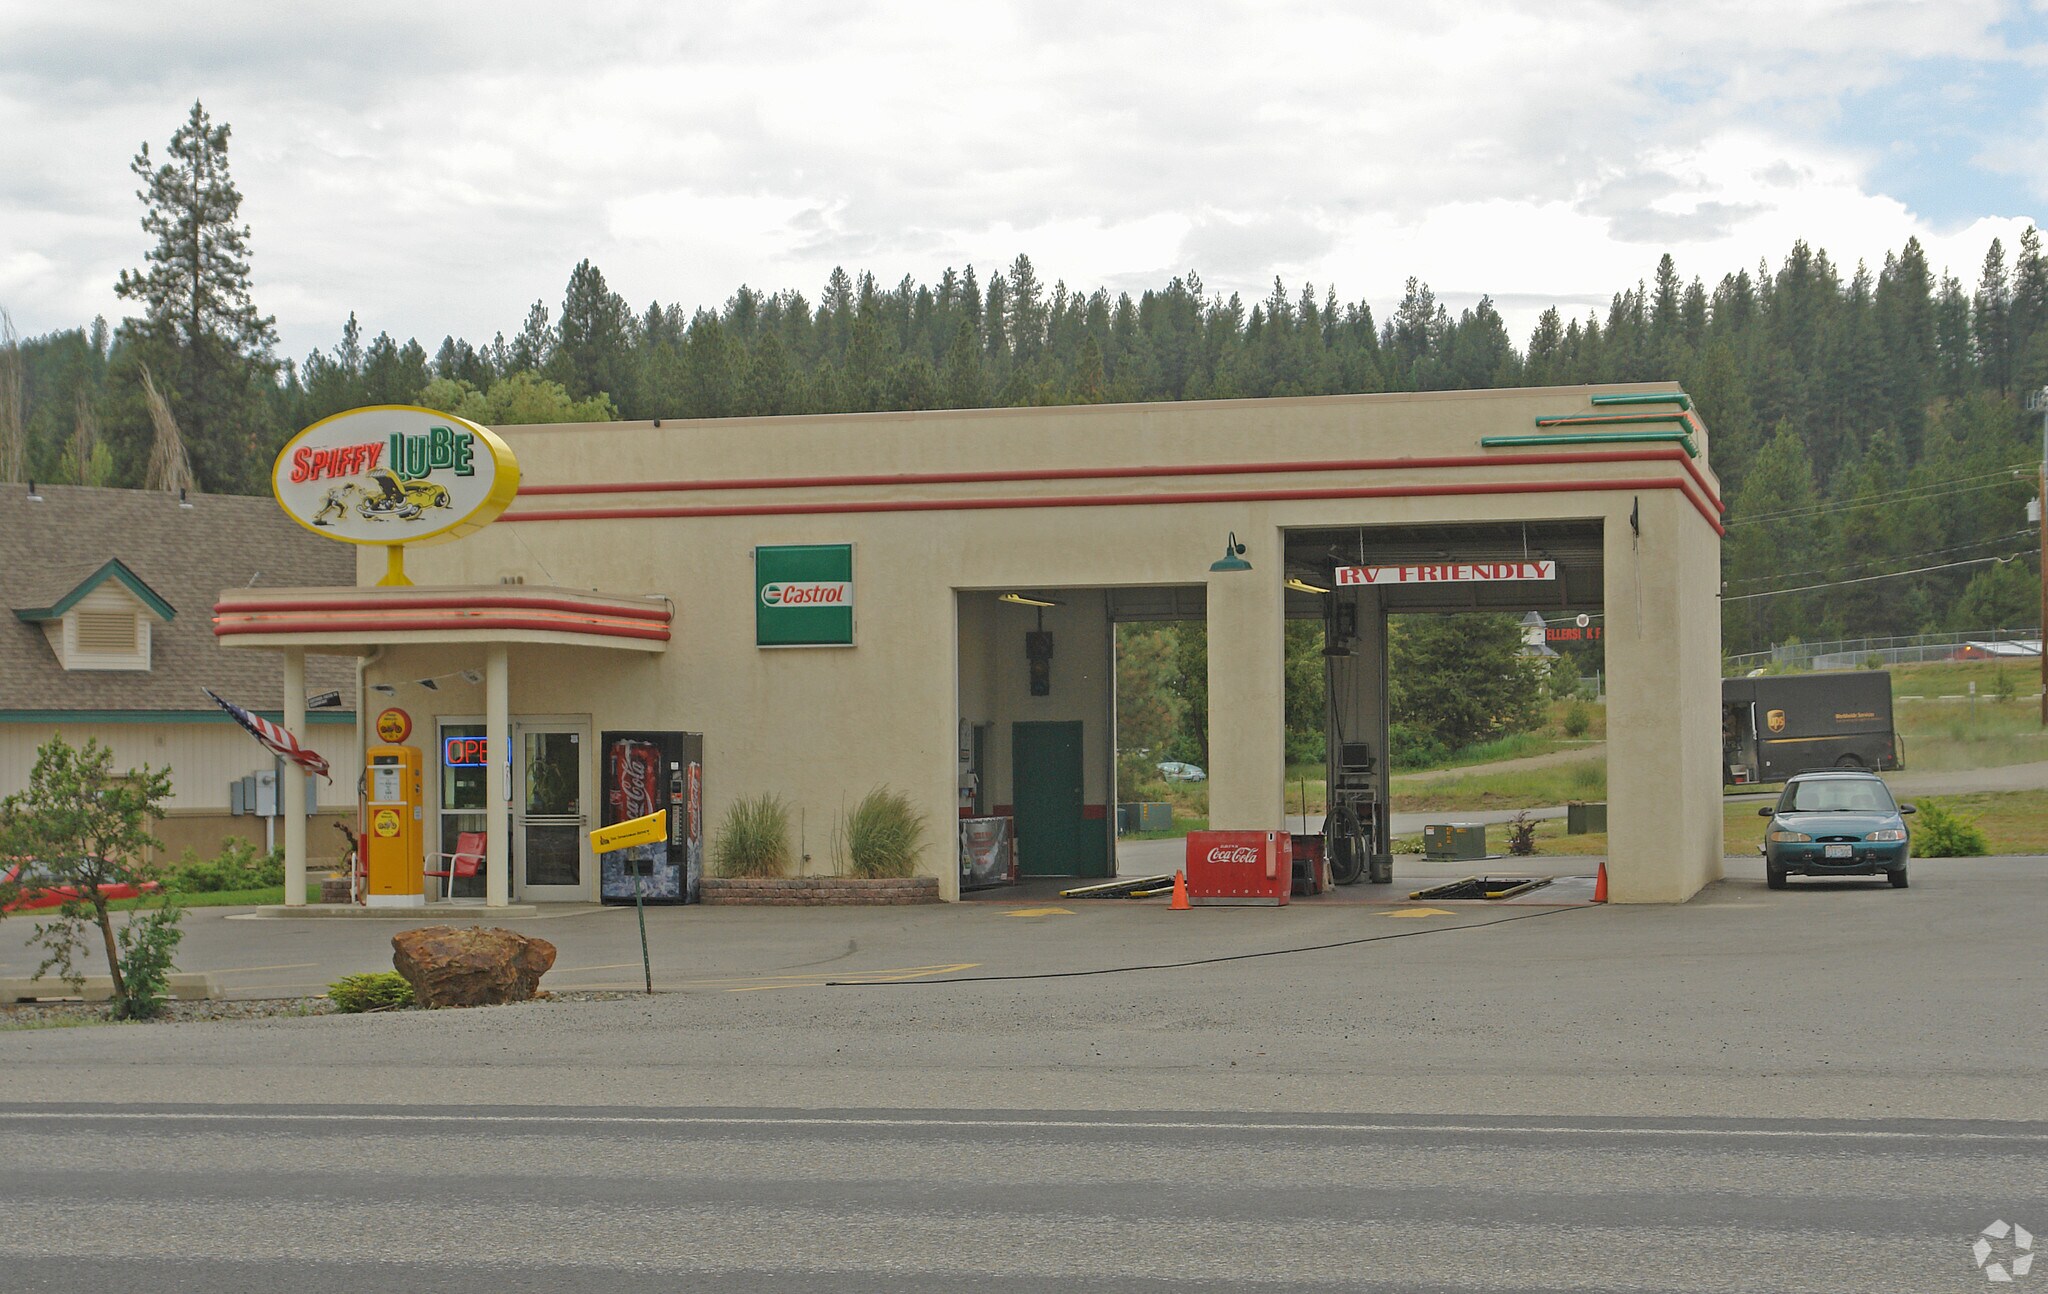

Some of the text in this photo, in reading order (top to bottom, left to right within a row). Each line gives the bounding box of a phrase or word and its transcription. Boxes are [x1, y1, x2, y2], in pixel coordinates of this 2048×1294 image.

[290, 425, 475, 484] SPIFFY LUBE
[1340, 563, 1551, 584] RV FRIENDLY
[782, 584, 845, 604] Castrol
[1770, 716, 1784, 730] ups
[447, 739, 488, 764] OPE
[1207, 847, 1259, 863] Coca-Cola
